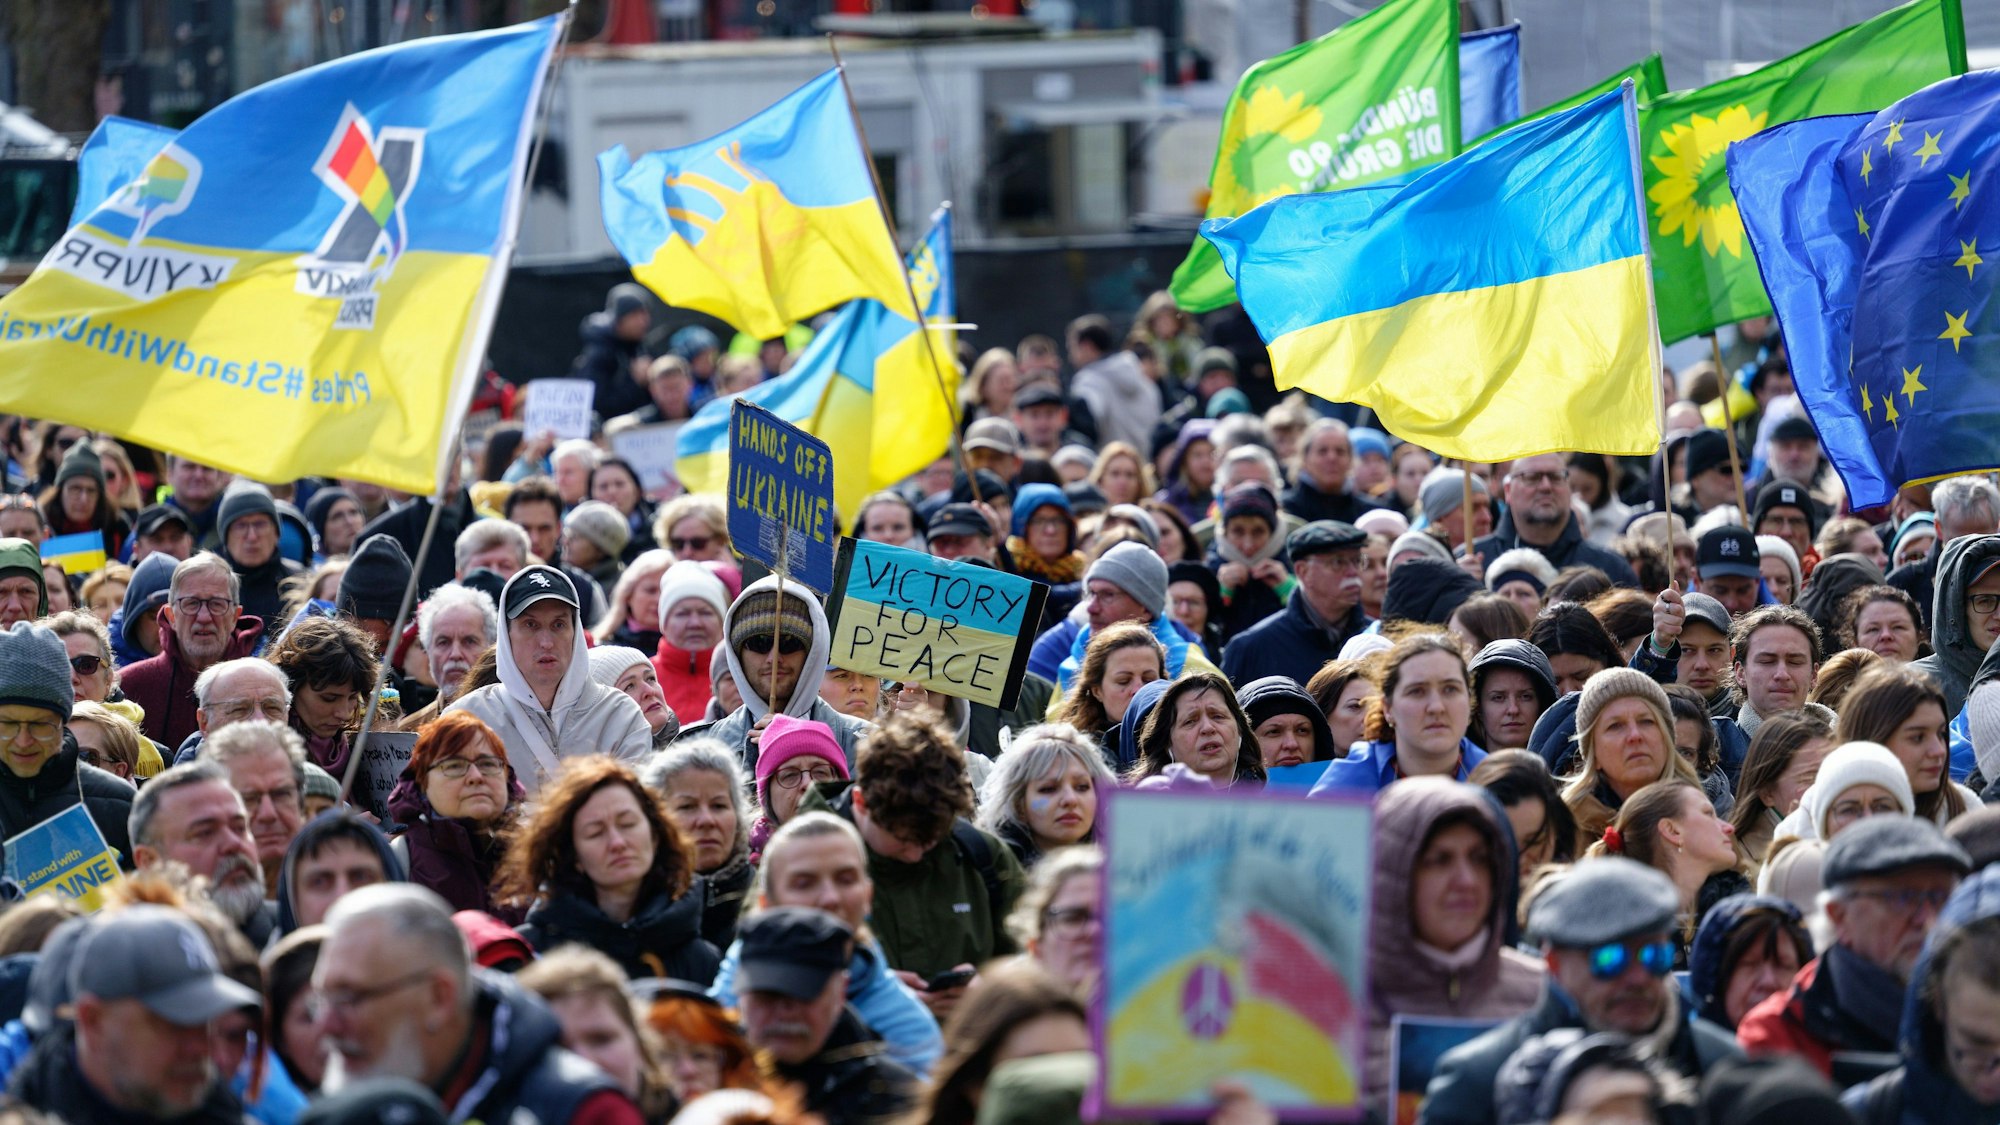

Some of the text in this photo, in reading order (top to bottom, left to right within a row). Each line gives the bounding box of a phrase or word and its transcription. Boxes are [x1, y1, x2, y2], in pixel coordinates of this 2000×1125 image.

[739, 410, 827, 485] HANDS OFF
[736, 462, 828, 543] UKRAINE
[864, 555, 1024, 624] VICTORY
[877, 600, 959, 646] FOR
[850, 625, 999, 692] PEACE
[27, 861, 58, 884] stand
[57, 849, 82, 867] with
